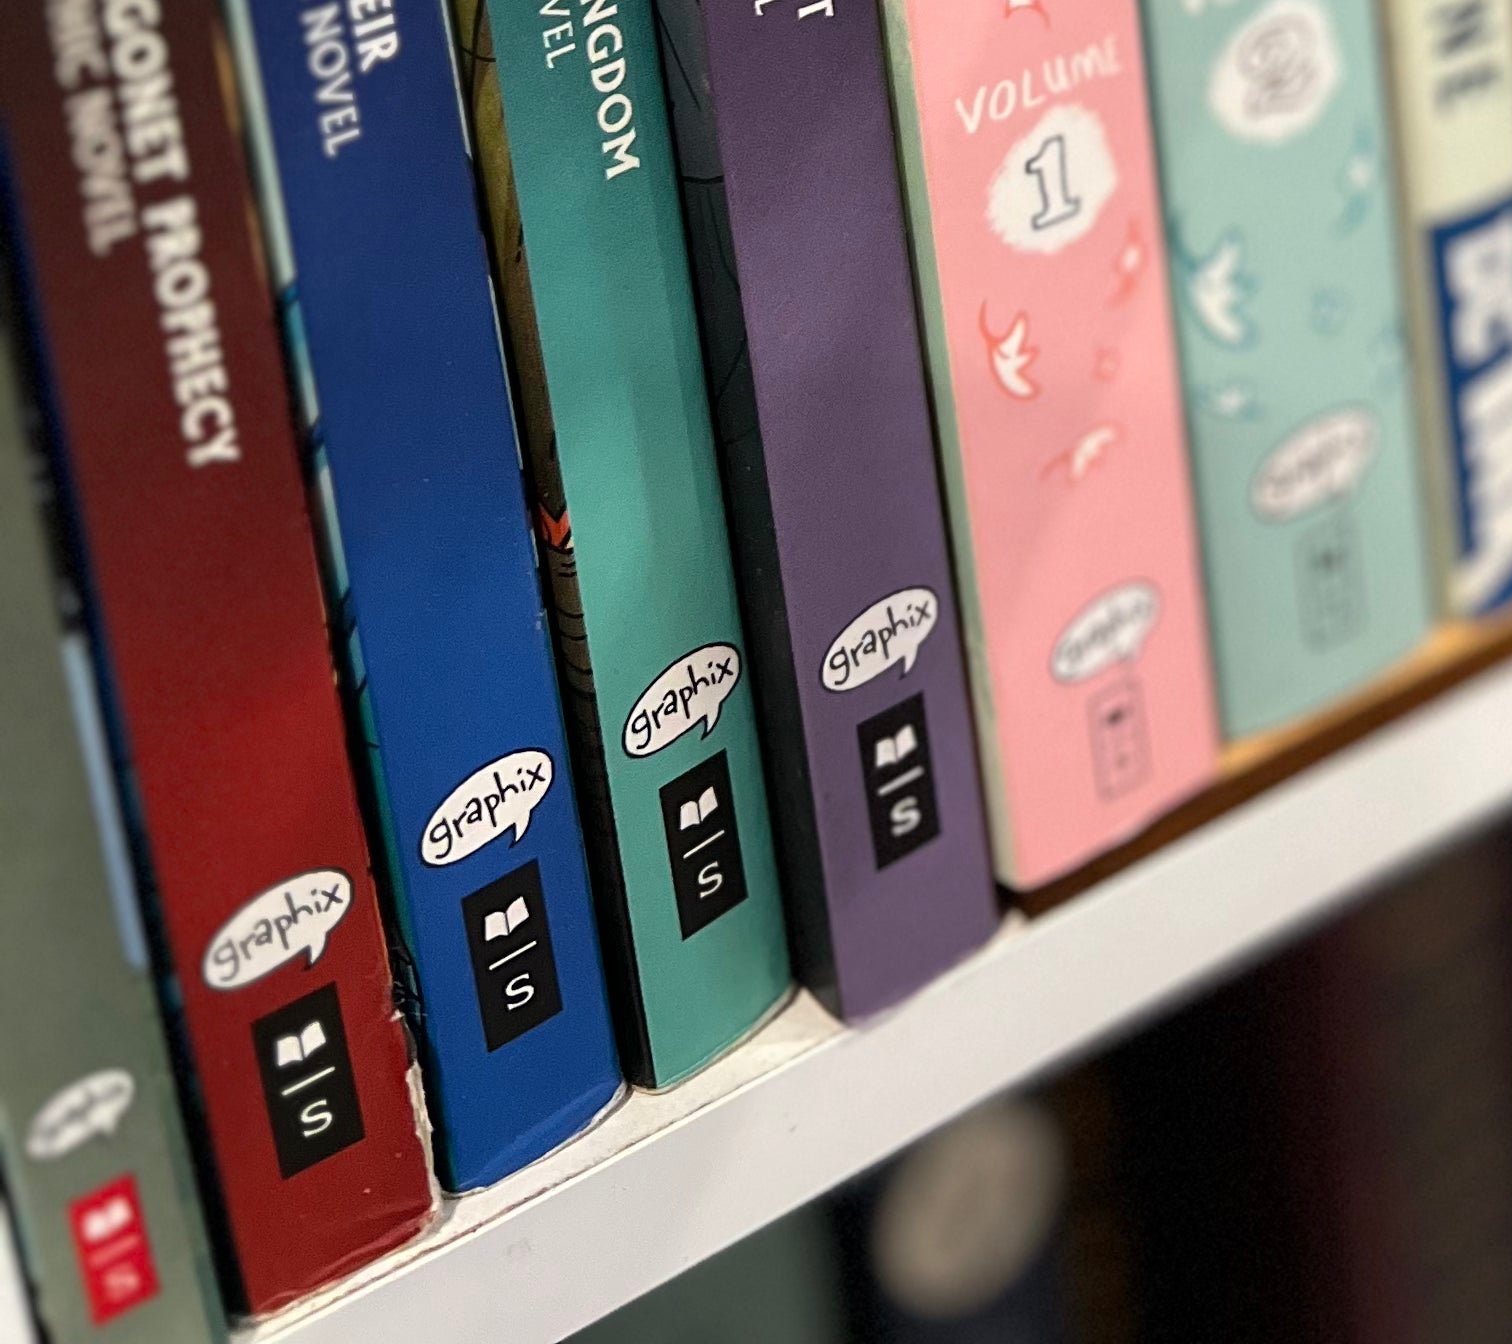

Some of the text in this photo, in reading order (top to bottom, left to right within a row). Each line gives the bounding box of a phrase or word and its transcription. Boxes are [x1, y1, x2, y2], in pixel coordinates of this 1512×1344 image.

[299, 5, 363, 159] NOVEL
[953, 33, 1125, 134] VOLUME
[1022, 134, 1085, 231] 1
[141, 195, 241, 468] PROPHECY
[828, 592, 934, 686] graphix
[628, 654, 738, 752] graphix
[429, 760, 549, 860] graphix
[890, 797, 922, 837] S
[697, 861, 724, 899] S
[213, 877, 346, 983] graphix
[504, 973, 536, 1011] S
[301, 1098, 334, 1139] S
